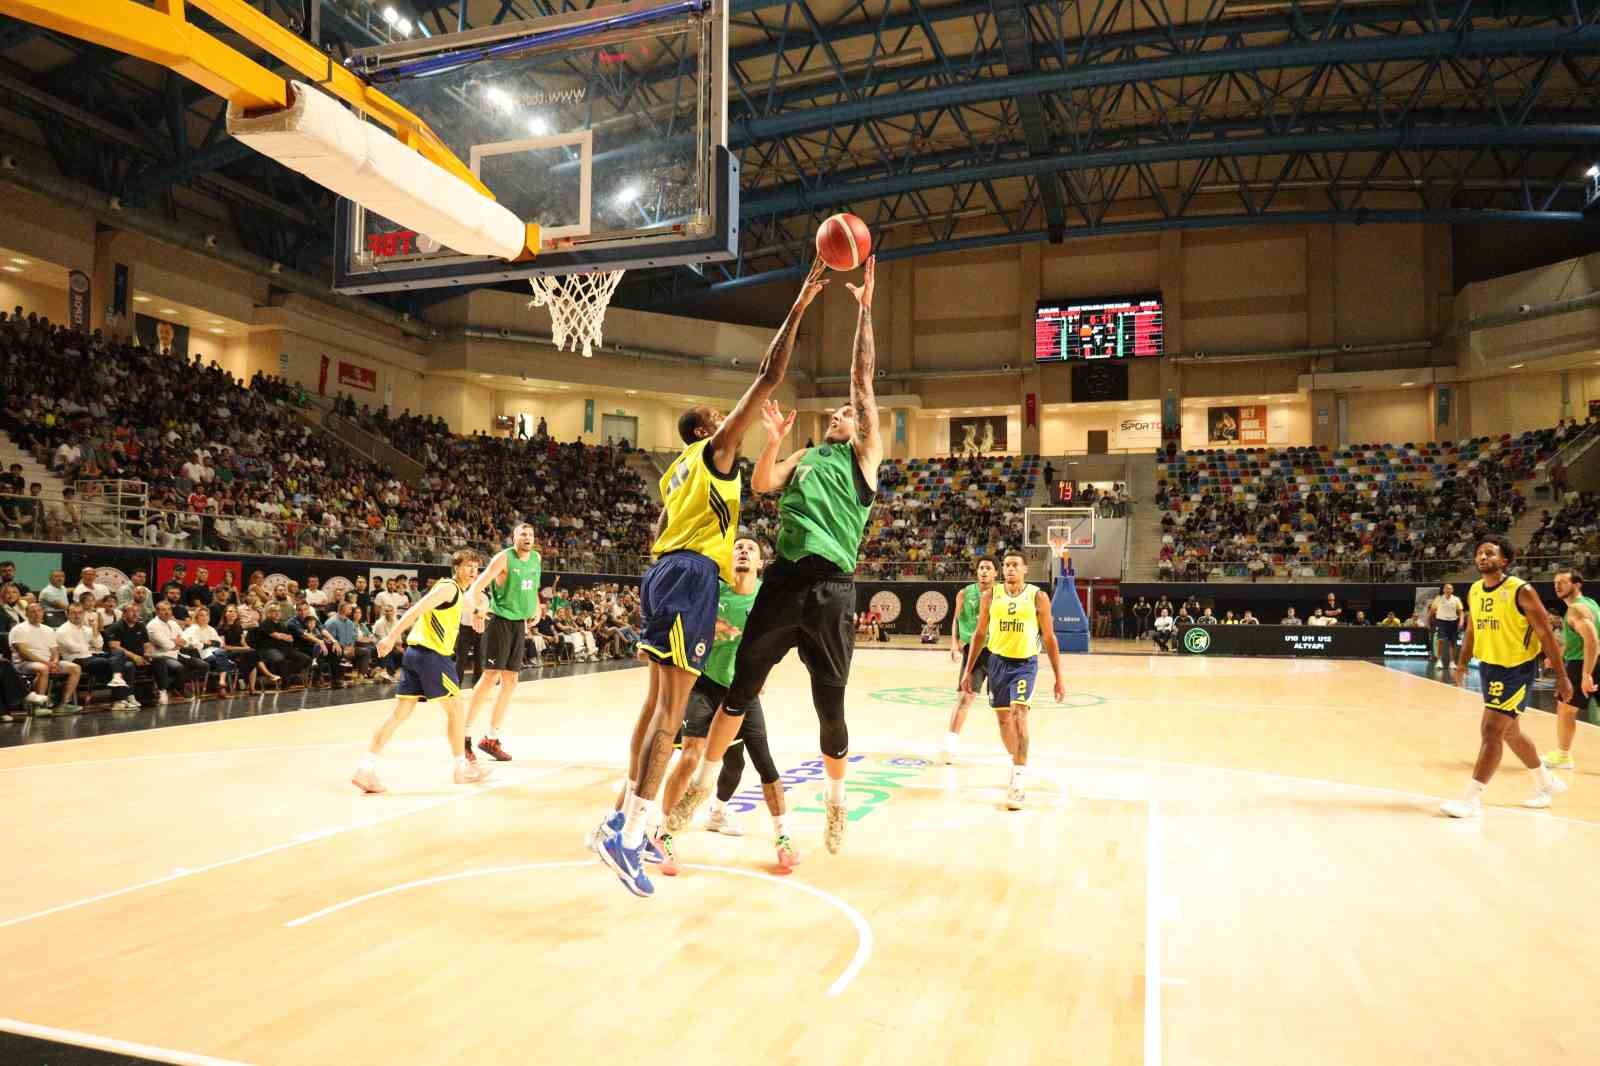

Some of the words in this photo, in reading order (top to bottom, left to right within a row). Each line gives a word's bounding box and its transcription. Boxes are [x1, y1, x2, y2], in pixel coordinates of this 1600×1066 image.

[1008, 602, 1017, 616] 2
[1481, 597, 1494, 613] 12
[1017, 679, 1027, 695] 2
